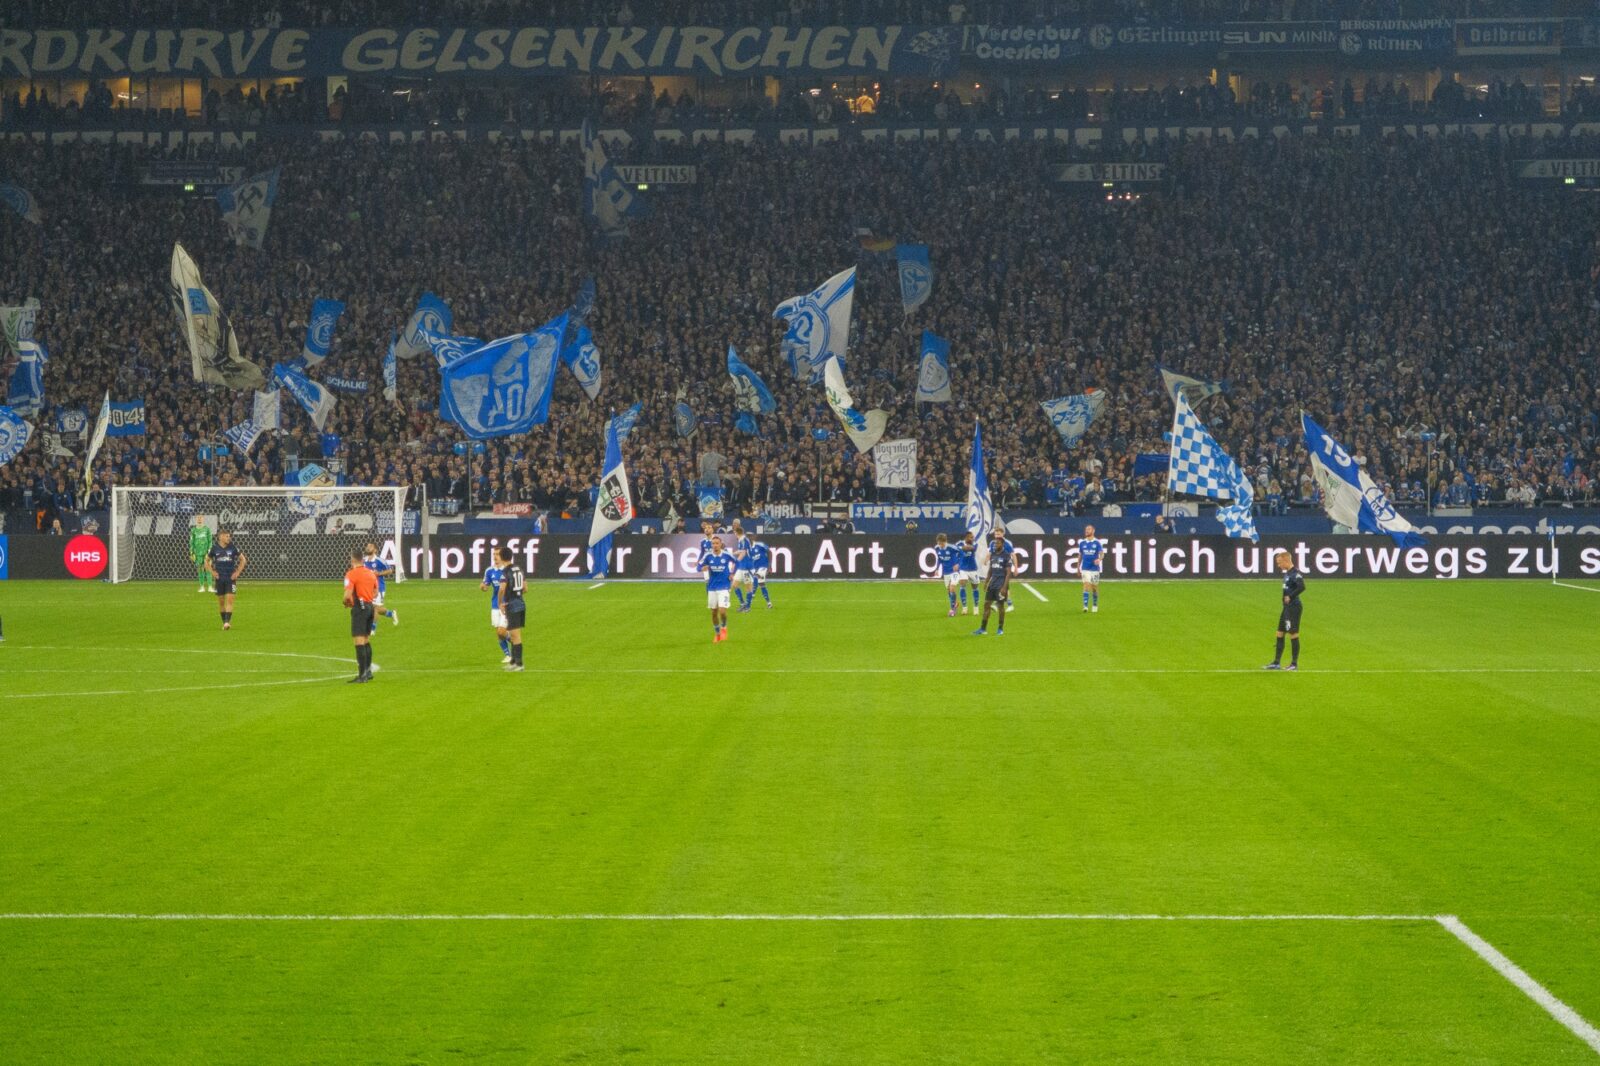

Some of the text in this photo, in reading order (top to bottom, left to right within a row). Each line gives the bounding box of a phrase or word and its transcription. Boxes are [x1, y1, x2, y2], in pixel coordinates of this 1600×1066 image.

[1223, 31, 1287, 44] SUN
[1368, 35, 1423, 51] RÜTHEN
[342, 25, 901, 76] GELSENKIRCHEN
[976, 43, 1061, 60] Coesfeld
[622, 168, 688, 184] VELTINS
[326, 375, 369, 391] SCHALKE
[70, 551, 100, 562] HRS
[559, 547, 631, 573] zr
[813, 540, 898, 578] Art,
[1237, 540, 1487, 578] unterwegs
[1508, 547, 1559, 573] zu
[513, 571, 524, 591] 10
